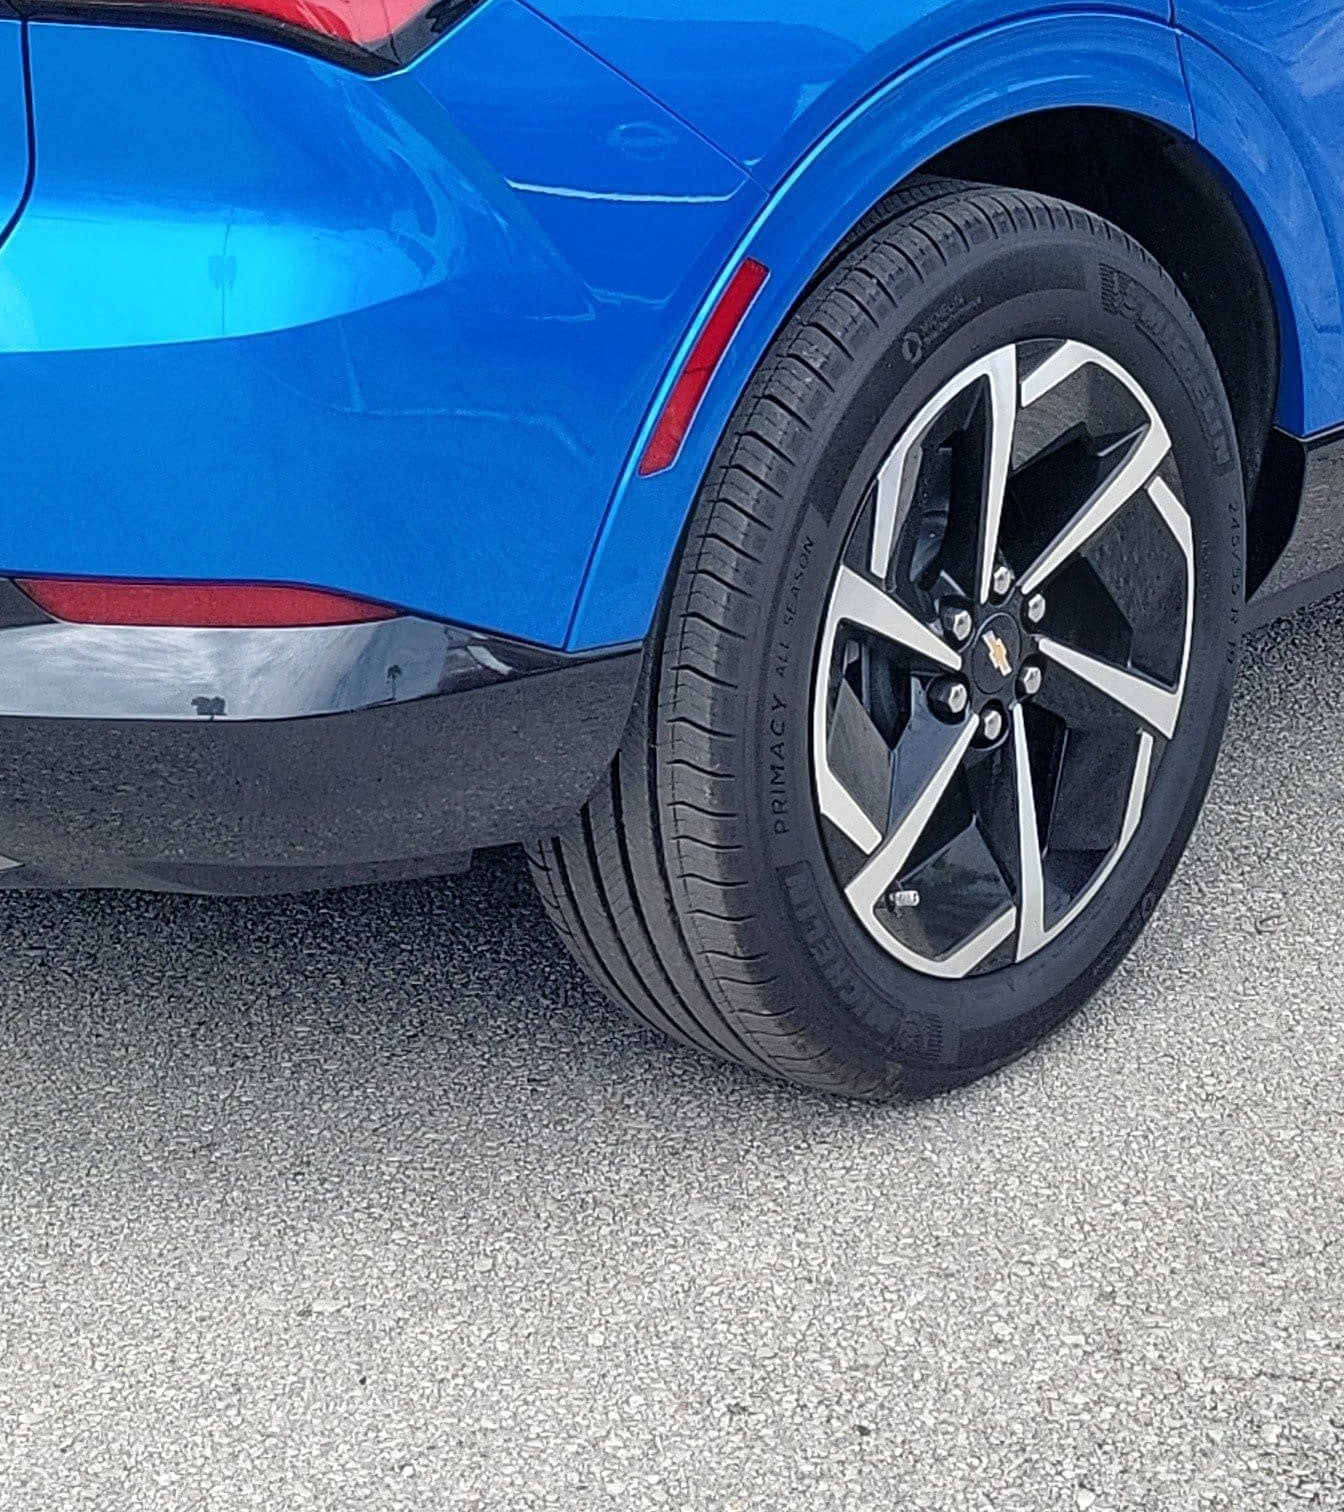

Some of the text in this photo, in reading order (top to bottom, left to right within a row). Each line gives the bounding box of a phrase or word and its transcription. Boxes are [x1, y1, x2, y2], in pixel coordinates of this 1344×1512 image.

[770, 537, 816, 838] PRIMACY ALL SEASON
